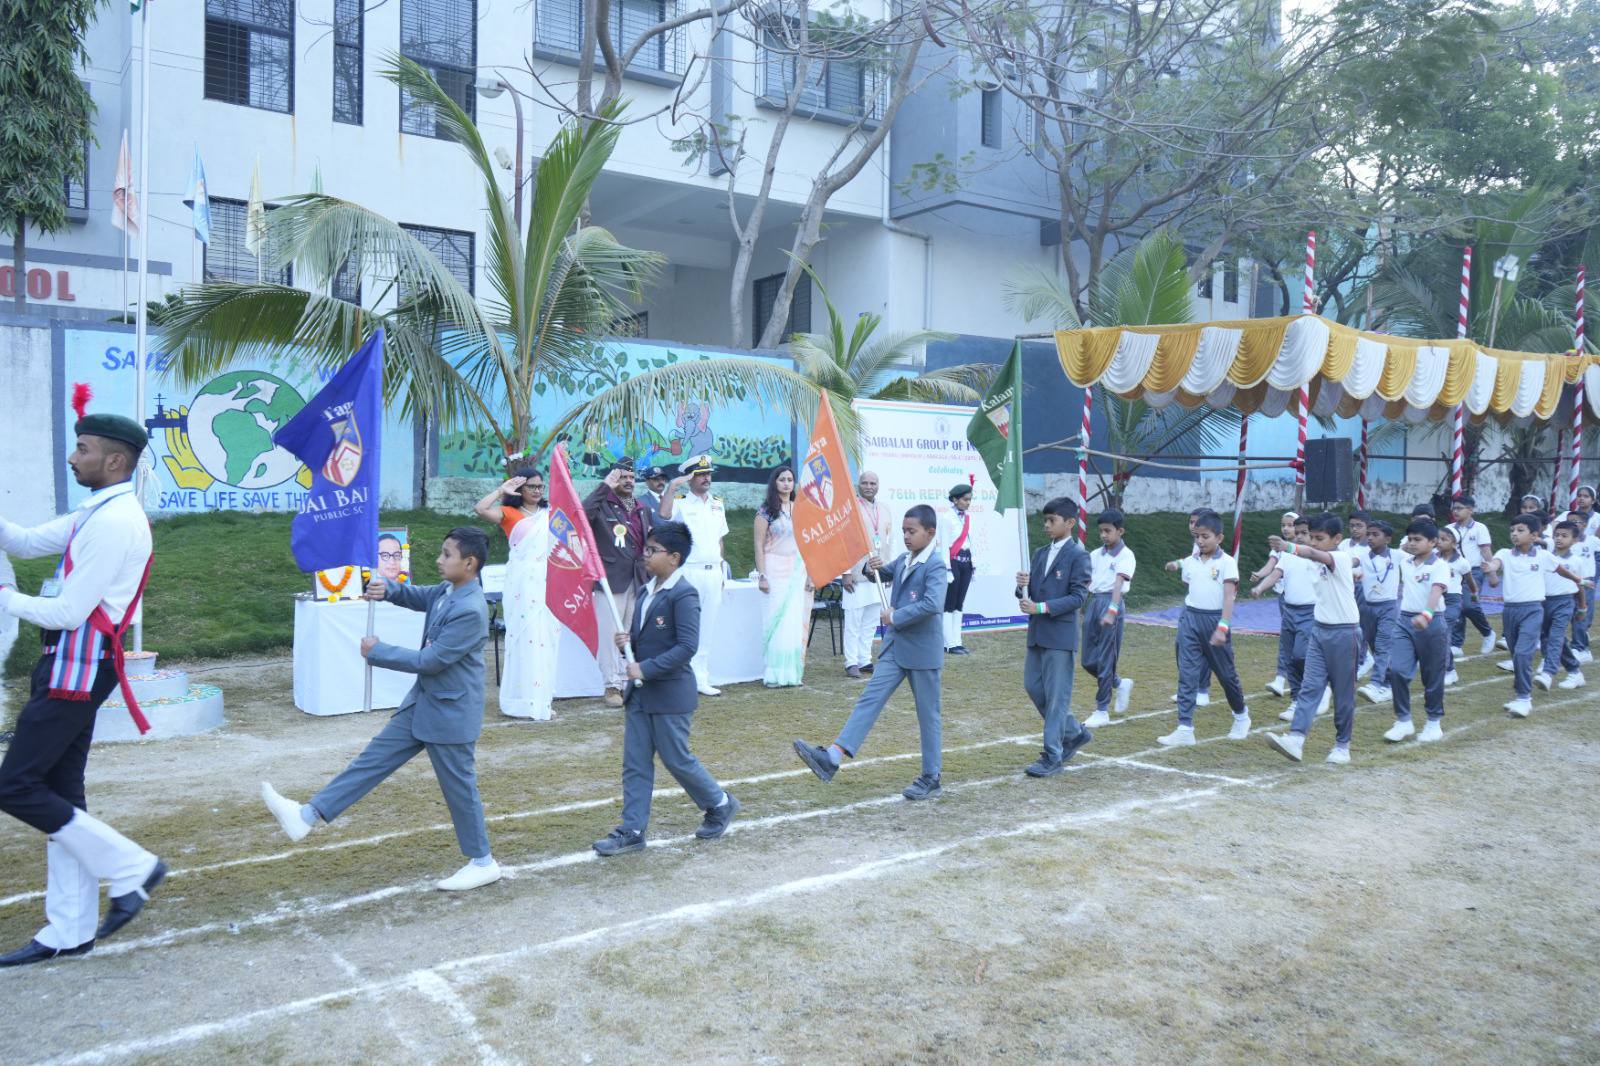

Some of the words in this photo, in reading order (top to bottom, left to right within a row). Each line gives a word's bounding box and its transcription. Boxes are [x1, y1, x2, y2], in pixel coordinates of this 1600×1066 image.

[916, 438, 949, 451] GROUP
[952, 440, 963, 451] OF
[158, 491, 198, 509] SAVE
[203, 491, 238, 508] LIFE
[242, 491, 280, 509] SAVE
[889, 488, 916, 500] 76th
[981, 489, 998, 501] DA
[313, 508, 351, 523] PUBLIC
[802, 522, 824, 544] SAI
